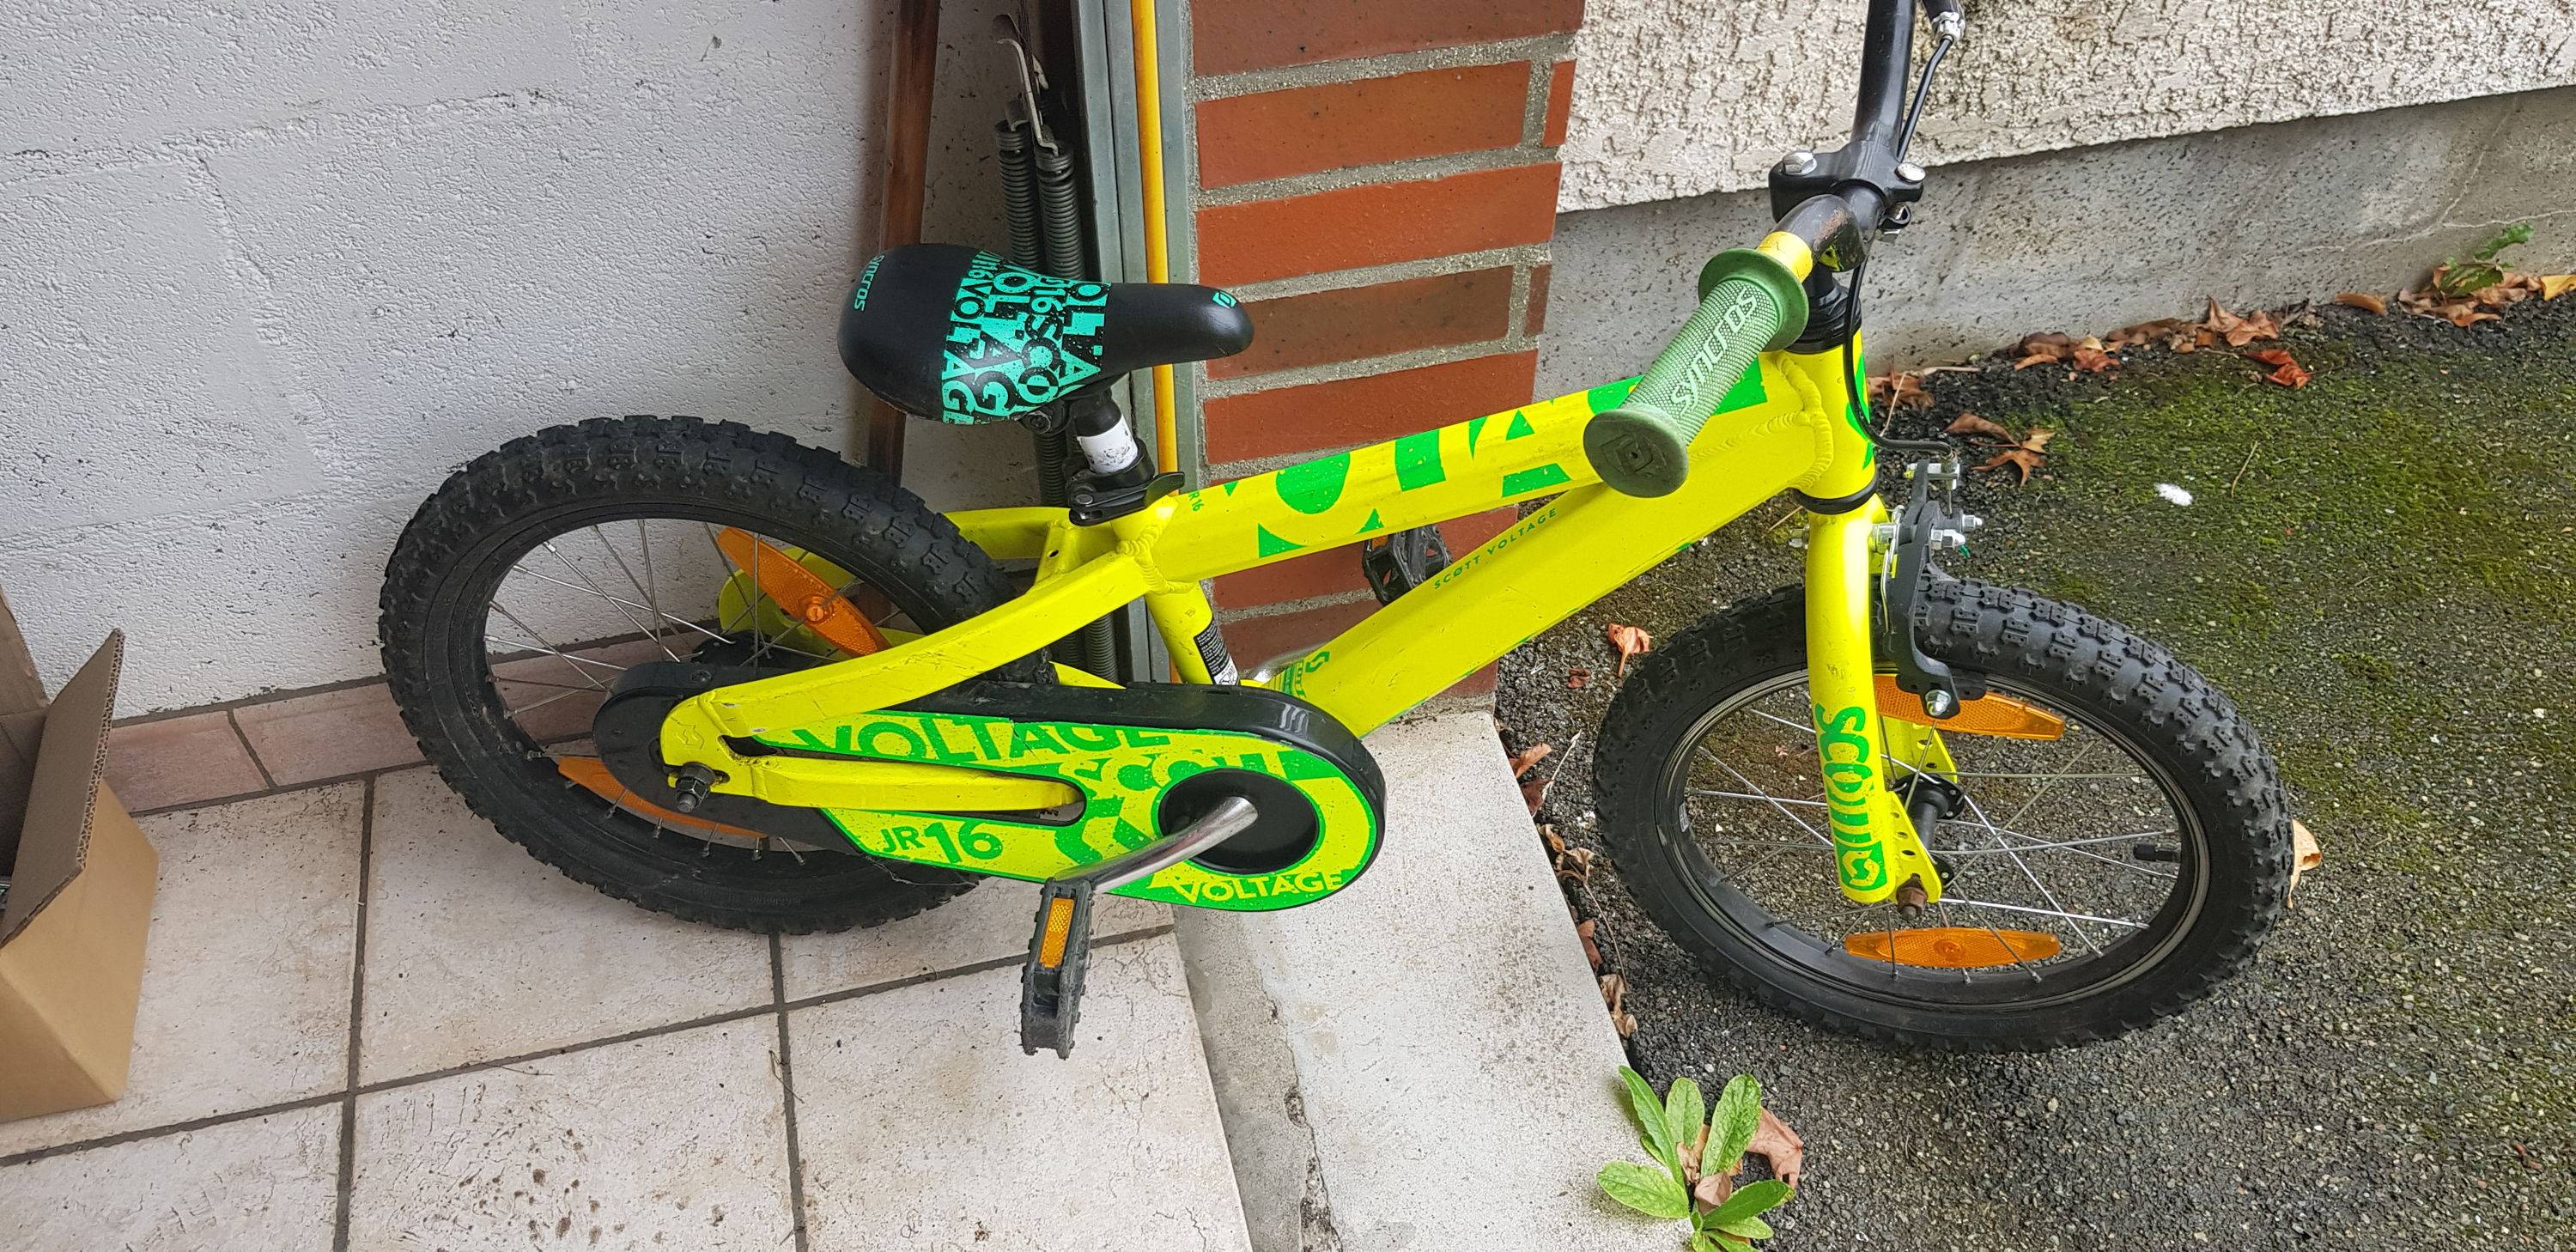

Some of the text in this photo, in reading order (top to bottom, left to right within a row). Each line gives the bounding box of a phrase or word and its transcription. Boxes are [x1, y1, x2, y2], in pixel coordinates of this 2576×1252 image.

[1486, 507, 1557, 556] VOLTAGE
[795, 716, 1170, 763] VOLTAGE
[1168, 869, 1346, 904] VOLTAGE
